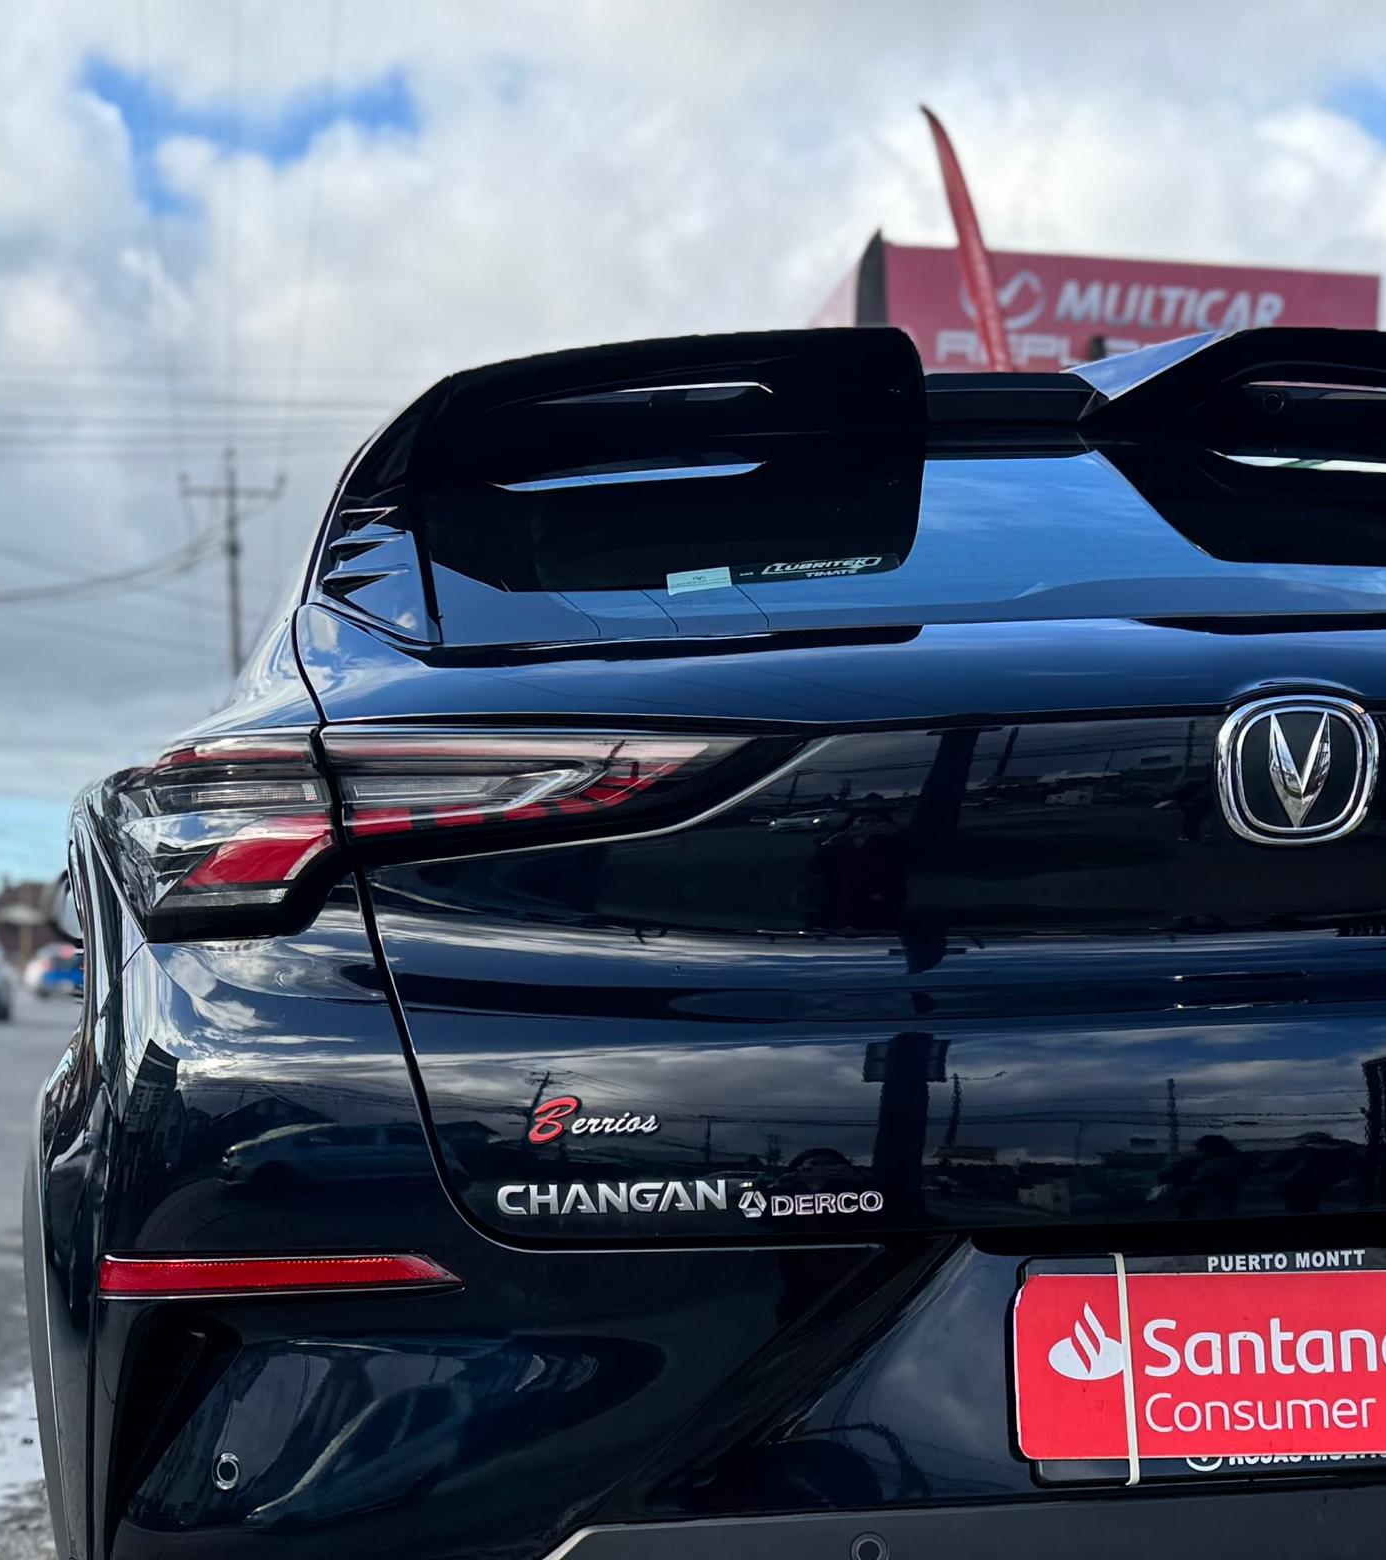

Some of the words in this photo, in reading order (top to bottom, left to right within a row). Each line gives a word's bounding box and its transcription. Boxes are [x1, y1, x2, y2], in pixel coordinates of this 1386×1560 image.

[1054, 279, 1286, 330] MULTICAR
[528, 1095, 662, 1144] Berrios
[496, 1179, 727, 1216] CHANGAN
[770, 1191, 884, 1217] DERCO
[1207, 1253, 1288, 1273] PUERTO
[1295, 1249, 1366, 1269] MONTT
[1144, 1392, 1377, 1433] Consumer
